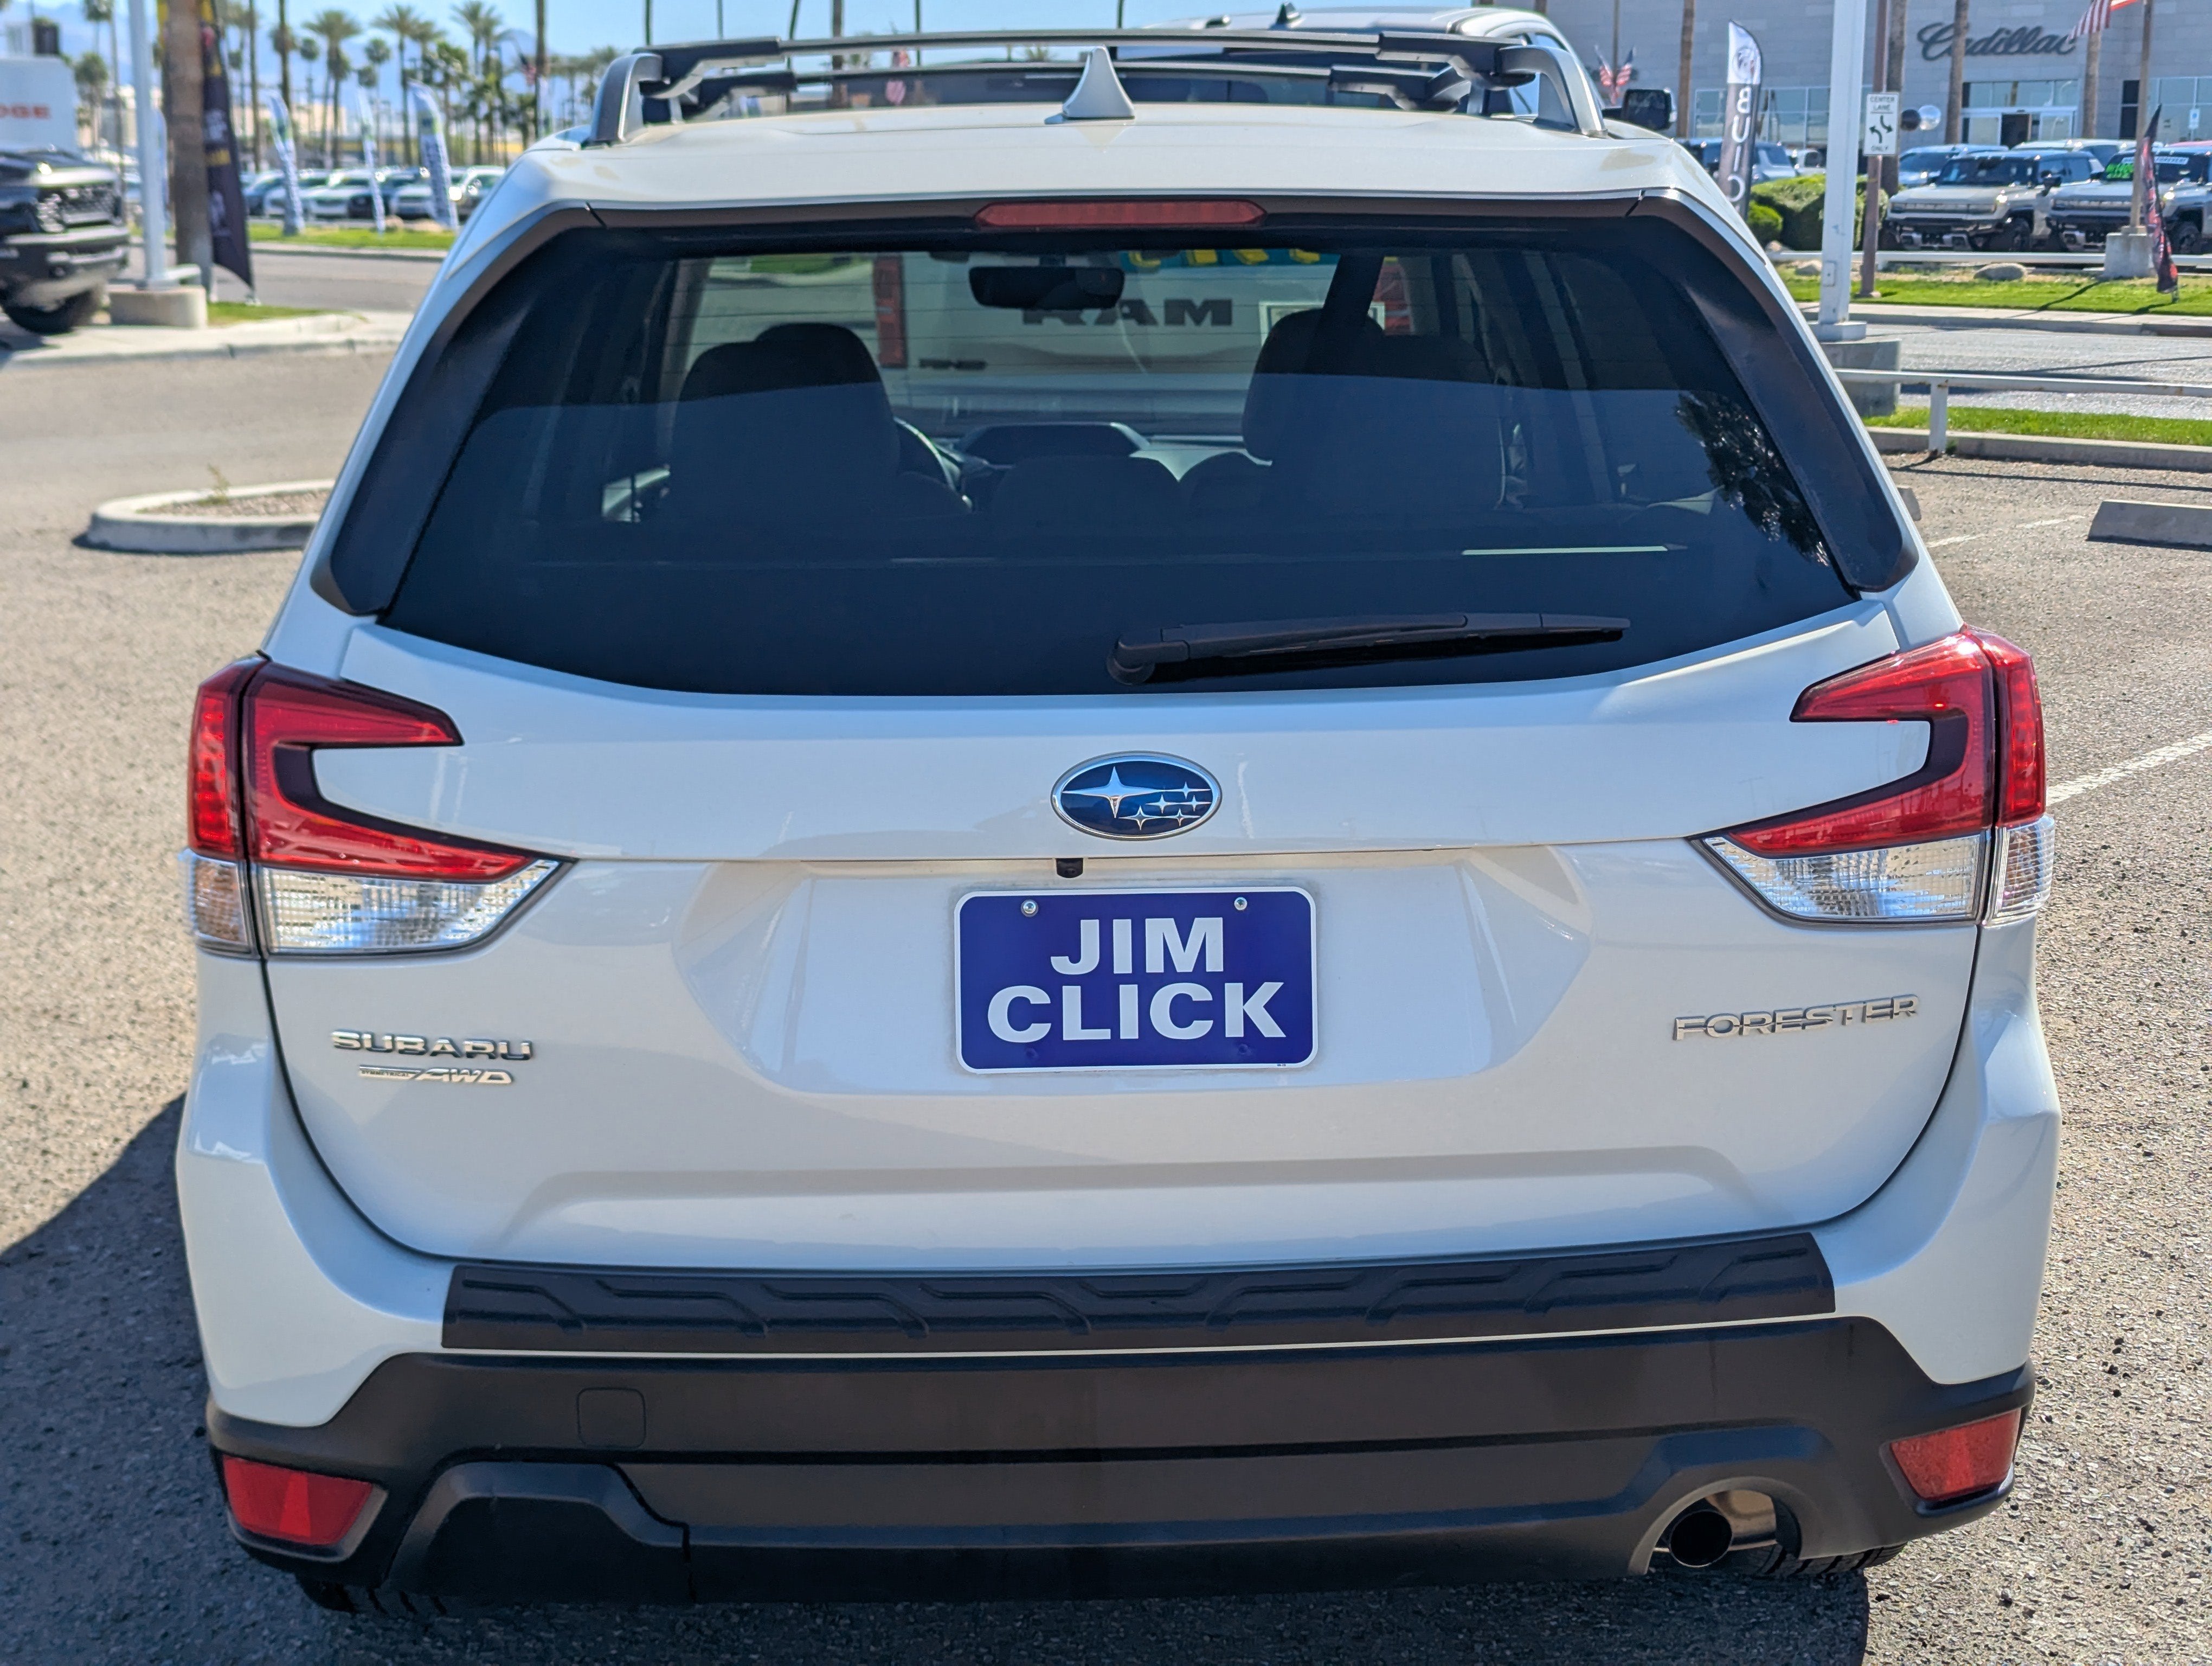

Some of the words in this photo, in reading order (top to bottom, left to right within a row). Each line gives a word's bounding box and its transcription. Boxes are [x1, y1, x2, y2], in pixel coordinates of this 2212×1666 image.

[1051, 917, 1224, 975] JIM
[987, 982, 1287, 1043] CLICK
[1673, 994, 1918, 1041] FORESTER
[331, 1030, 533, 1061] SUBARU
[416, 1068, 514, 1085] AWD
